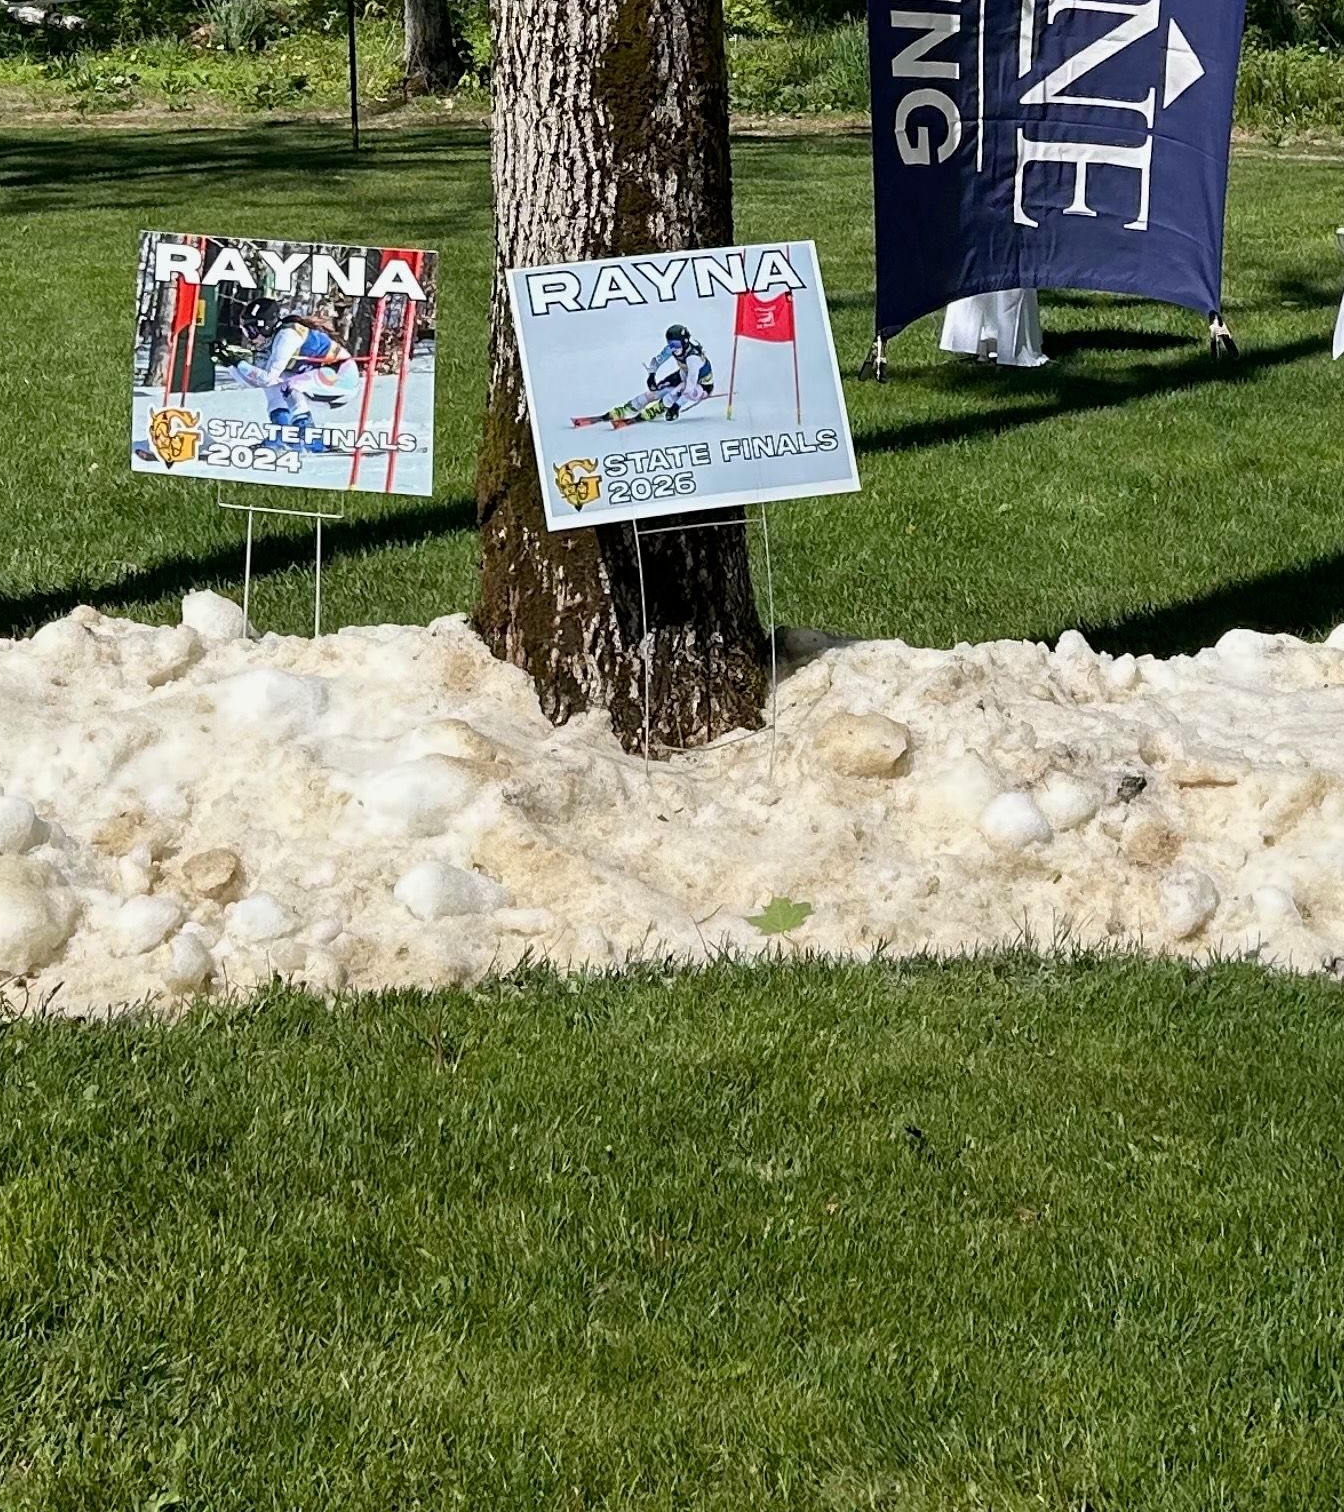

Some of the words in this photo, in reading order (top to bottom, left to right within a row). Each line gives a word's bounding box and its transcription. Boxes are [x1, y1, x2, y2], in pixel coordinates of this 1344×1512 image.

[155, 242, 427, 302] RAYNA
[525, 249, 807, 317] RAYNA
[207, 419, 300, 443] STATE
[304, 427, 417, 453] FINALS
[602, 442, 711, 478] STATE
[720, 428, 839, 463] FINALS
[207, 445, 303, 474] 2024
[608, 471, 697, 505] 2026
